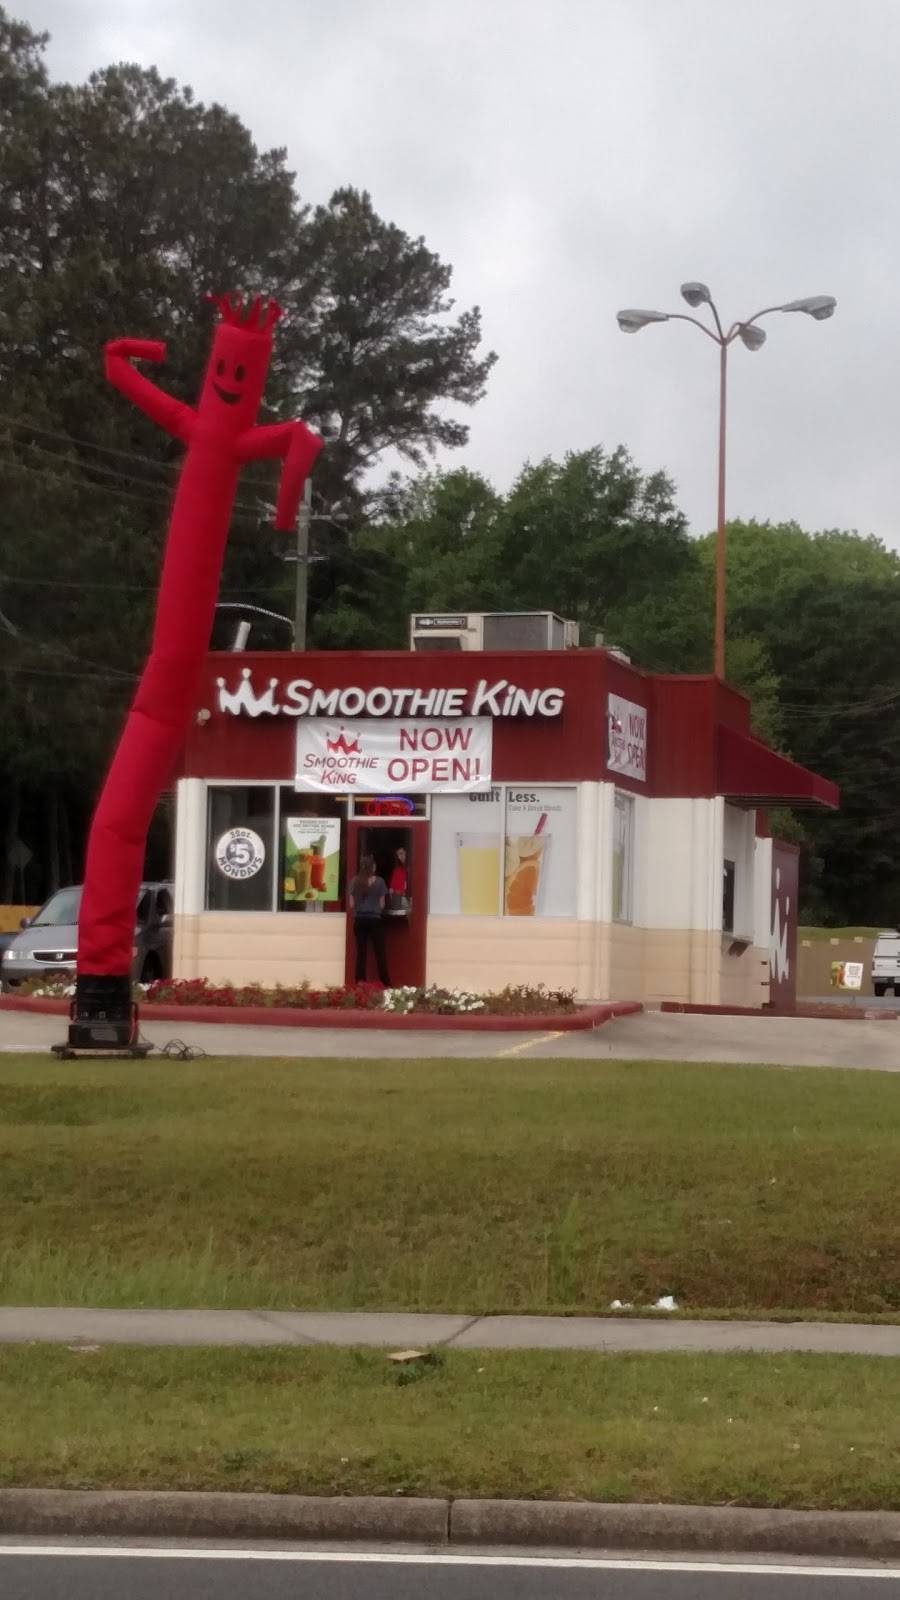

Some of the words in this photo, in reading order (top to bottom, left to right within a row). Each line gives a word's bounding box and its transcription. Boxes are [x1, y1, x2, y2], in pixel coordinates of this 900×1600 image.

[283, 680, 467, 716] SMOOTHIE
[400, 727, 473, 751] NOW
[303, 753, 380, 769] SMOOTHIE
[387, 758, 481, 782] OPEN!
[509, 791, 540, 803] Less.
[217, 856, 263, 878] MONDAYS
